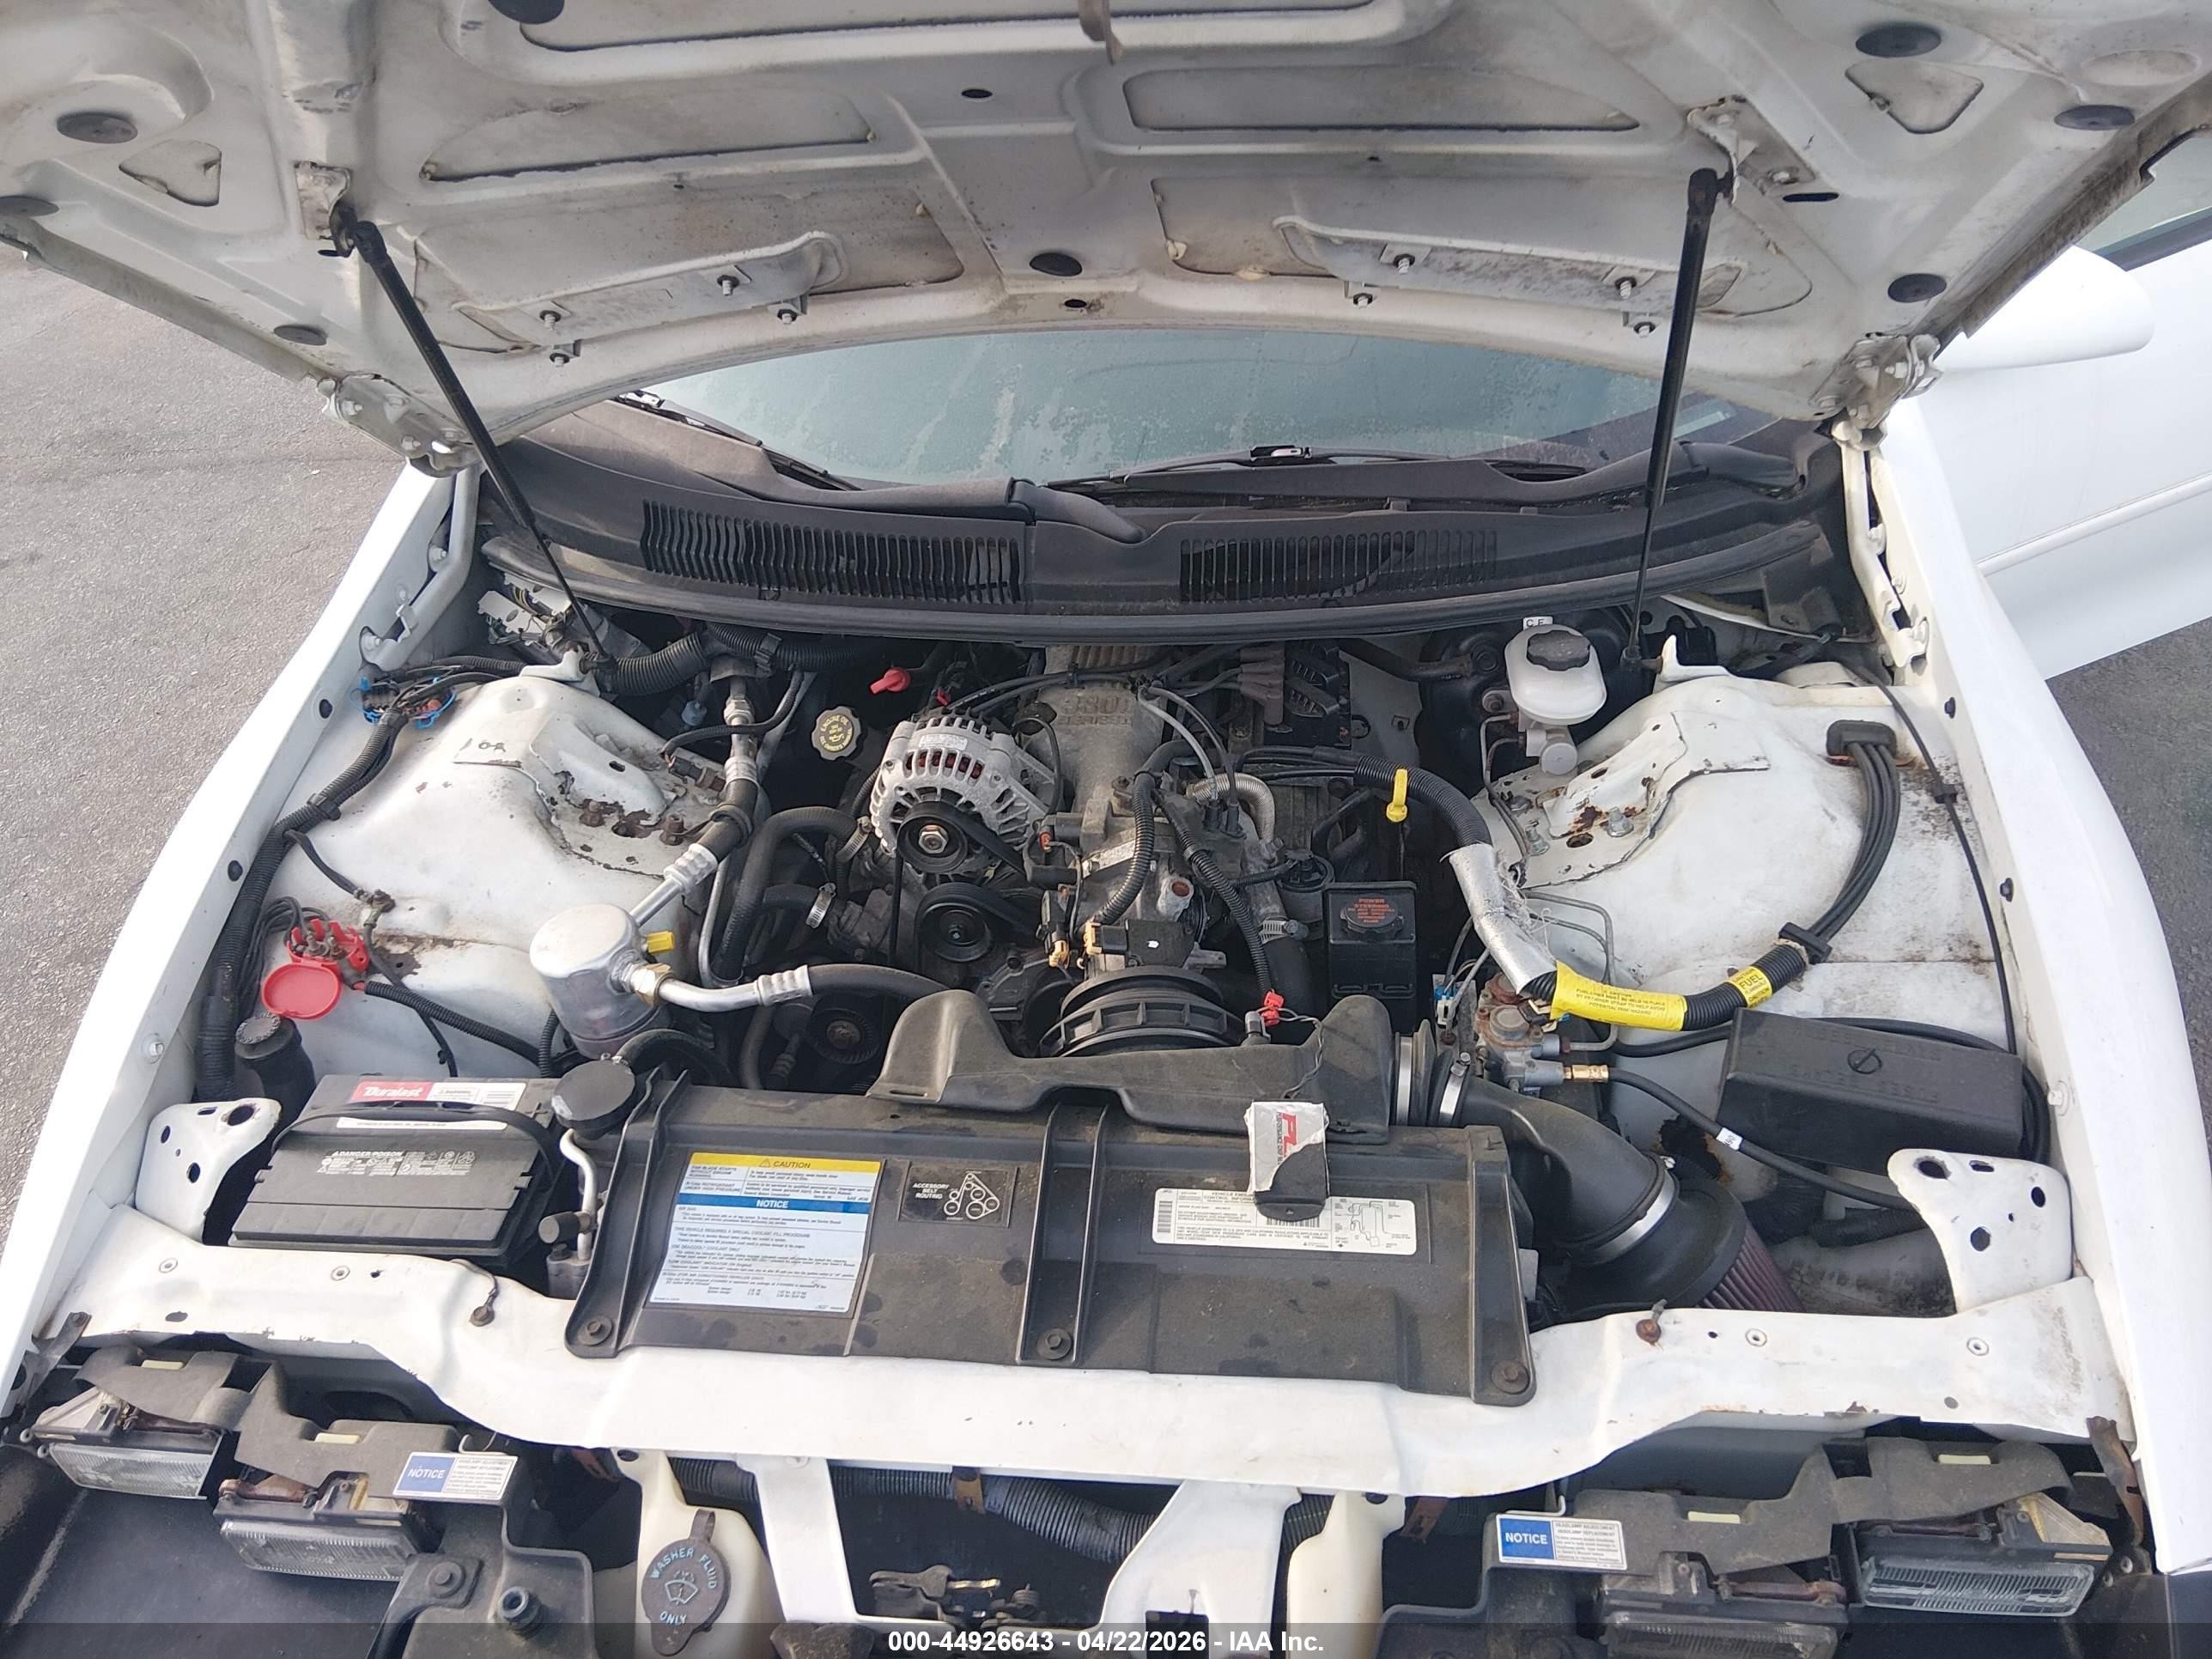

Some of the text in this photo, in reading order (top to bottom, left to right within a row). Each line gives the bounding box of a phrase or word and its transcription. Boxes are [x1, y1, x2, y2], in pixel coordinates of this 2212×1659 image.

[1739, 974, 1765, 990] FUEL
[363, 1085, 425, 1099] Duralast
[773, 1160, 811, 1169] CAUTION
[757, 1199, 789, 1208] NOTICE
[408, 1468, 446, 1479] NOTICE
[1505, 1532, 1548, 1545] NOTICE
[650, 1547, 718, 1589] WASHER FLUID
[659, 1610, 687, 1624] ONLY
